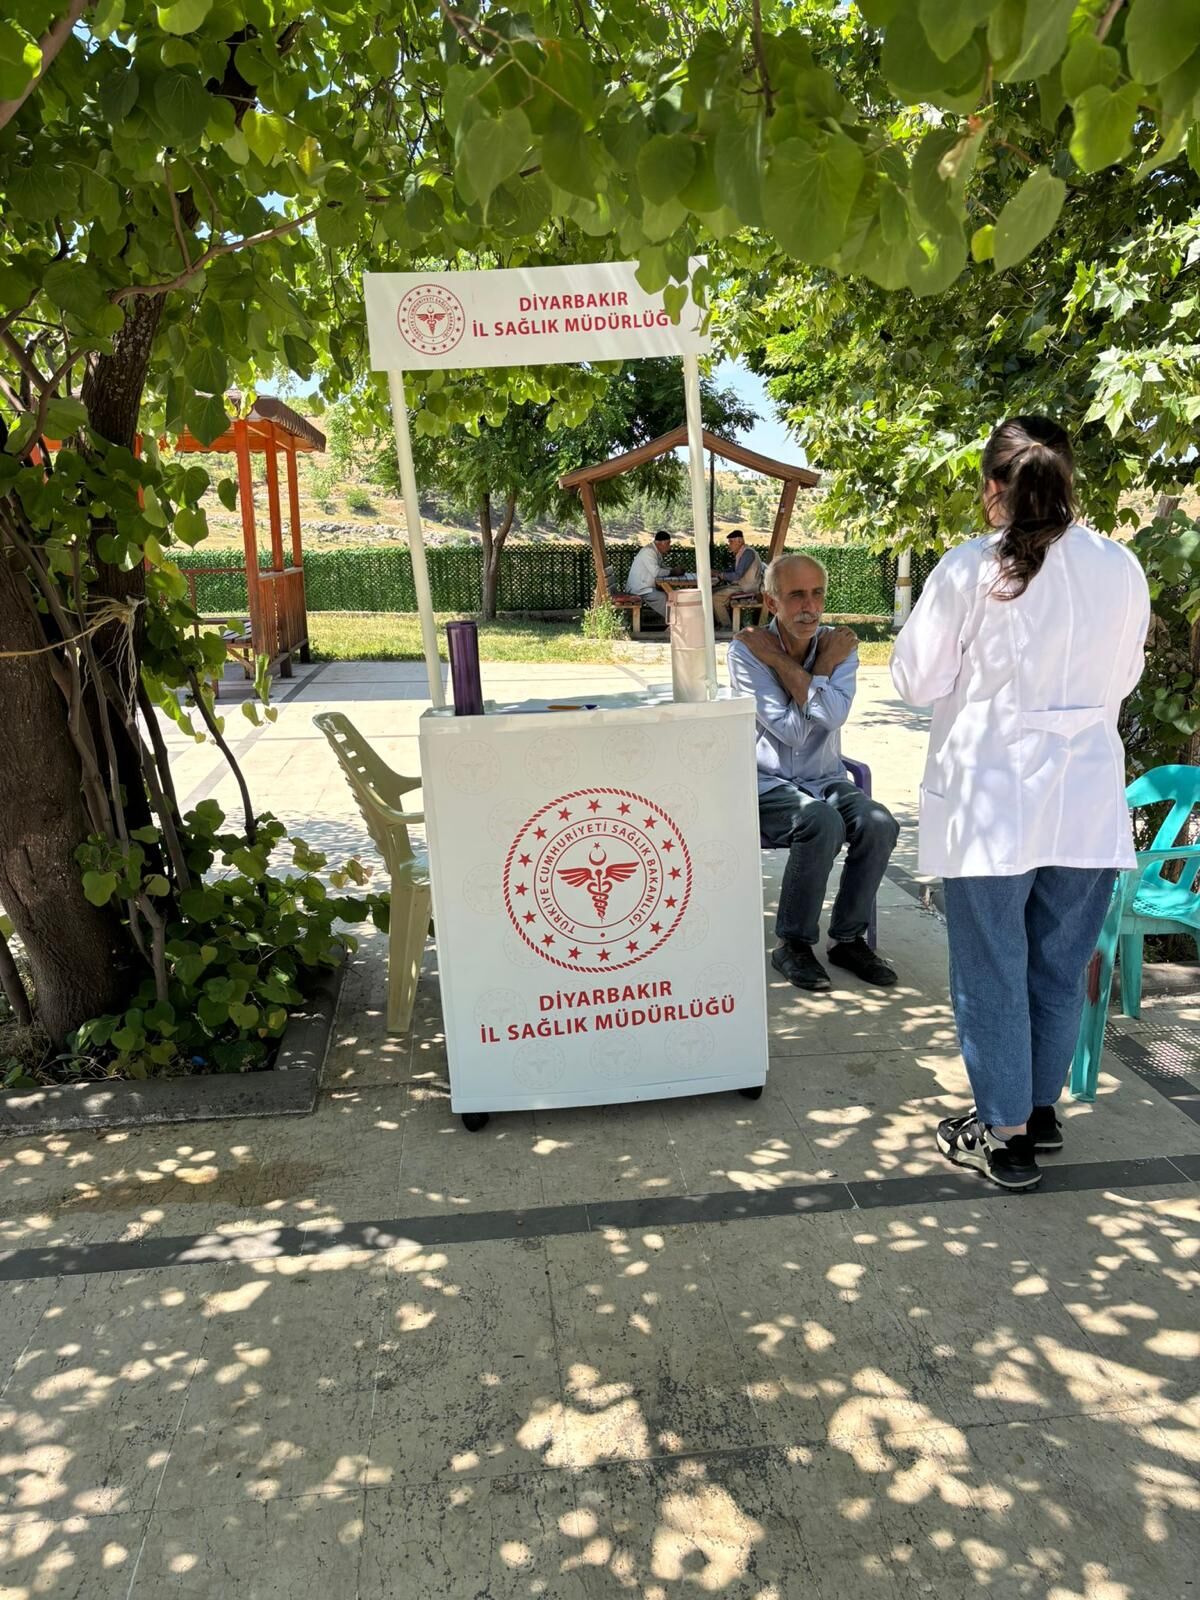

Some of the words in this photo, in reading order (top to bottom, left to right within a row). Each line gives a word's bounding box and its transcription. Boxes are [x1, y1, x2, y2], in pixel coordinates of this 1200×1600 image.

[518, 290, 628, 313] DİYARBAKIR
[472, 320, 489, 338] İL
[494, 316, 558, 337] SAĞLIK
[564, 308, 681, 334] MÜDÜRLÜĞ
[540, 821, 607, 883] CUMHURİYETİ
[611, 824, 652, 857] SAĞLIK
[540, 888, 576, 934] TÜRKİYE
[628, 859, 658, 926] BAKANLIĞI
[539, 980, 672, 1012] DİYARBAKIR
[480, 1023, 501, 1044] İL
[507, 1017, 588, 1041] SAĞLIK
[594, 996, 736, 1031] MÜDÜRLÜĞÜ
